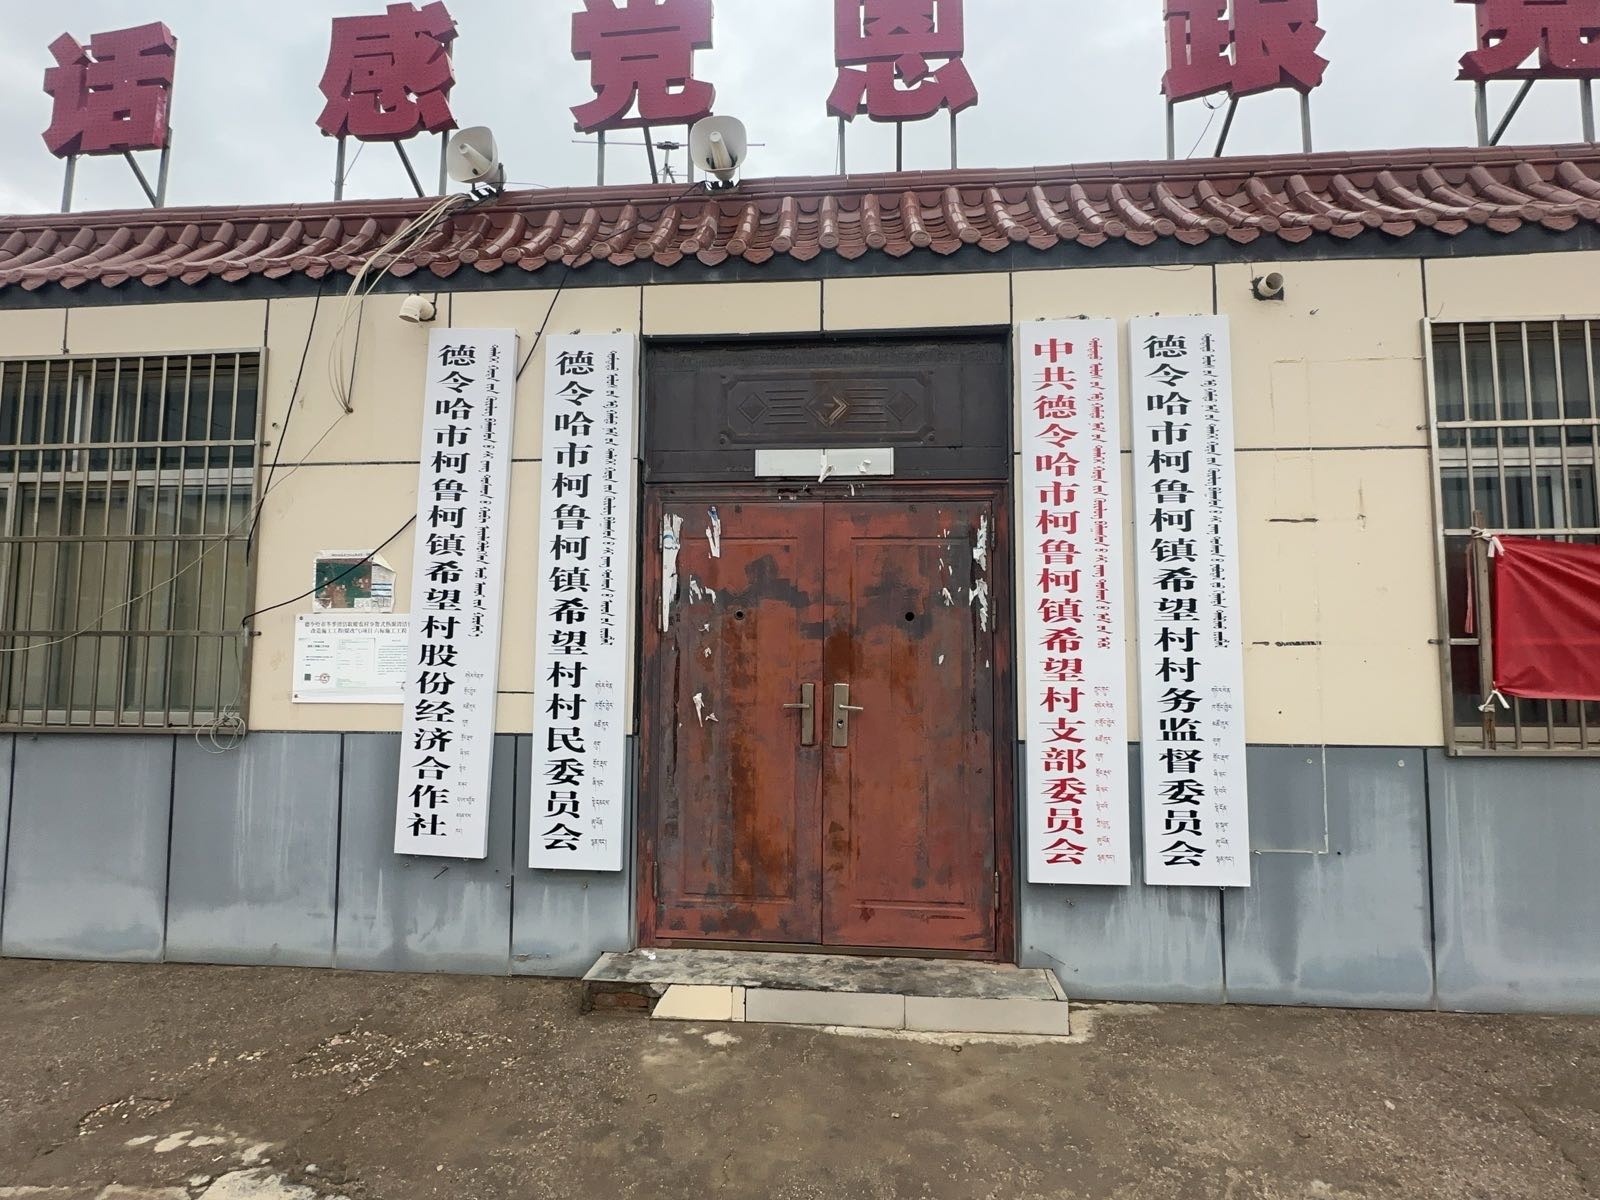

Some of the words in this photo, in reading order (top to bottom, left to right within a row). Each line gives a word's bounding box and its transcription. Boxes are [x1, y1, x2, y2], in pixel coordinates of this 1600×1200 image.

[407, 344, 476, 837] 德令哈市柯鲁柯镇希望村股份经济合作社
[541, 350, 595, 851] 德令哈市柯鲁柯镇希望村村民委员会
[1032, 338, 1088, 866] 中共德令哈市柯鲁柯镇希望村支部委员会
[1143, 334, 1207, 867] 德令哈市柯鲁柯镇希望村村务监督委员会
